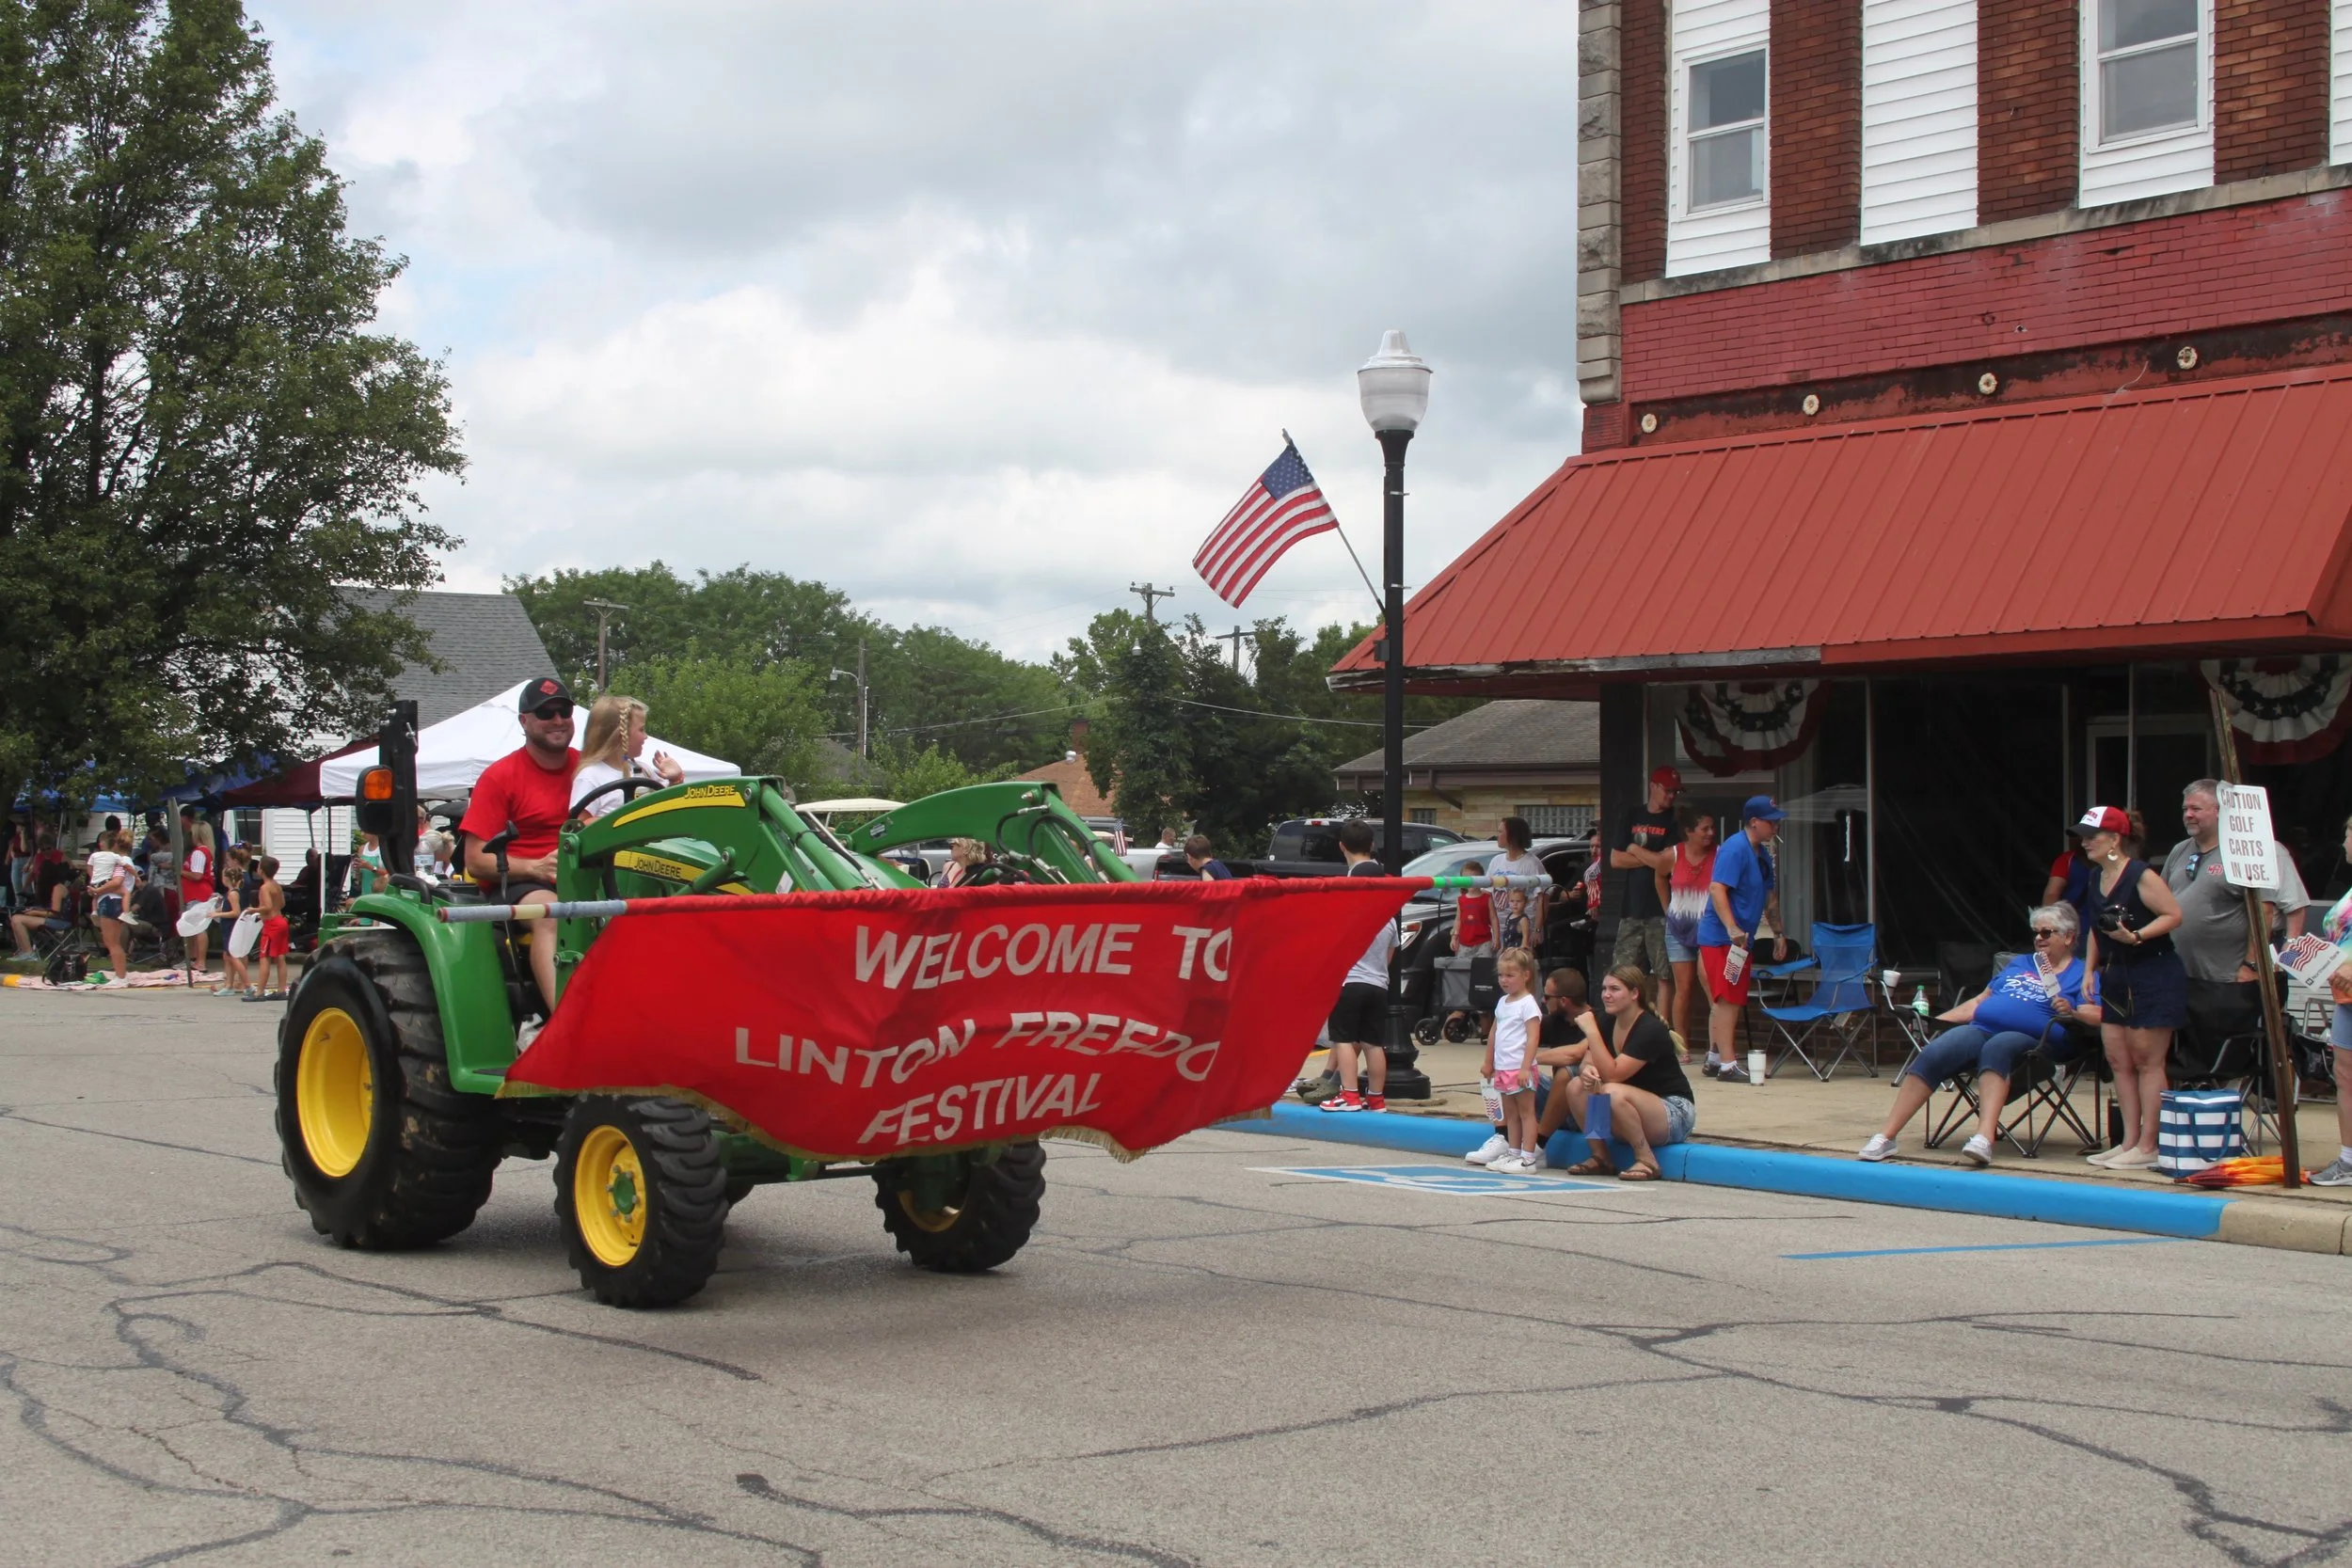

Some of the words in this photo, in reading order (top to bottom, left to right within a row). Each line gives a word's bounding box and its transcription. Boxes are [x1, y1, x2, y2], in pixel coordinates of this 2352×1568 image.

[2221, 789, 2262, 810] CAUTION
[2229, 815, 2255, 832] GOLF
[2229, 838, 2264, 857] CARTS
[2231, 862, 2242, 879] IN
[2245, 863, 2270, 881] USE.
[853, 923, 1141, 990] WELCOME
[1171, 925, 1232, 982] TO
[735, 1018, 977, 1088] LINTON
[993, 1011, 1220, 1082] FREEDO
[856, 1073, 1103, 1146] FESTIVAL
